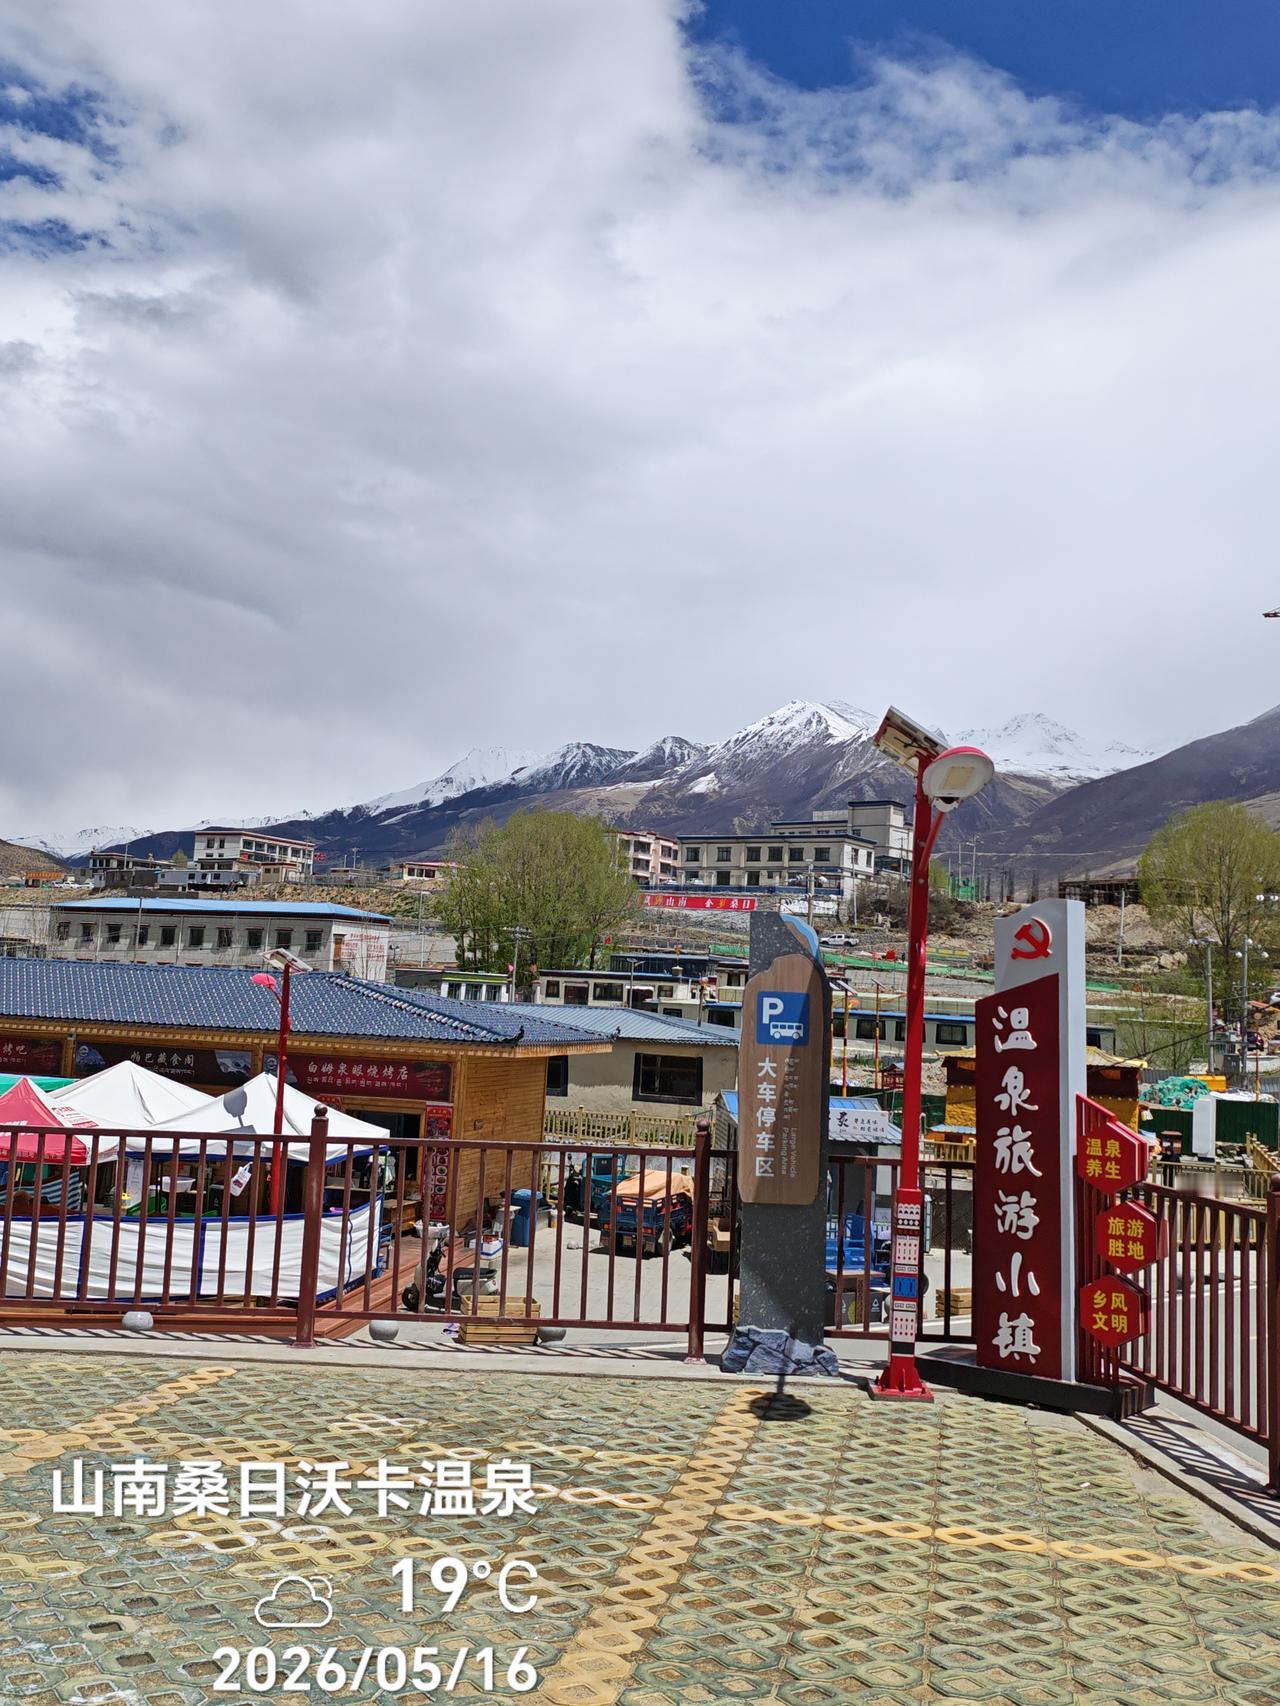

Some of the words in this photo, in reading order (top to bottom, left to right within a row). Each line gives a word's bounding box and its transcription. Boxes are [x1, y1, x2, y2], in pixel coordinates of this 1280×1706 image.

[763, 997, 784, 1024] P
[755, 1057, 777, 1177] 大车停车区
[780, 1127, 789, 1156] Parking
[789, 1127, 798, 1150] Large
[1086, 1138, 1121, 1158] 温泉
[781, 1157, 789, 1175] Area
[790, 1150, 798, 1178] Vehicle
[1086, 1158, 1121, 1180] 养生
[992, 1006, 1043, 1364] 温泉旅游小镇
[1108, 1216, 1144, 1238] 旅游
[1108, 1239, 1144, 1260] 胜地
[1093, 1290, 1128, 1312] 乡风
[1093, 1311, 1128, 1333] 文明
